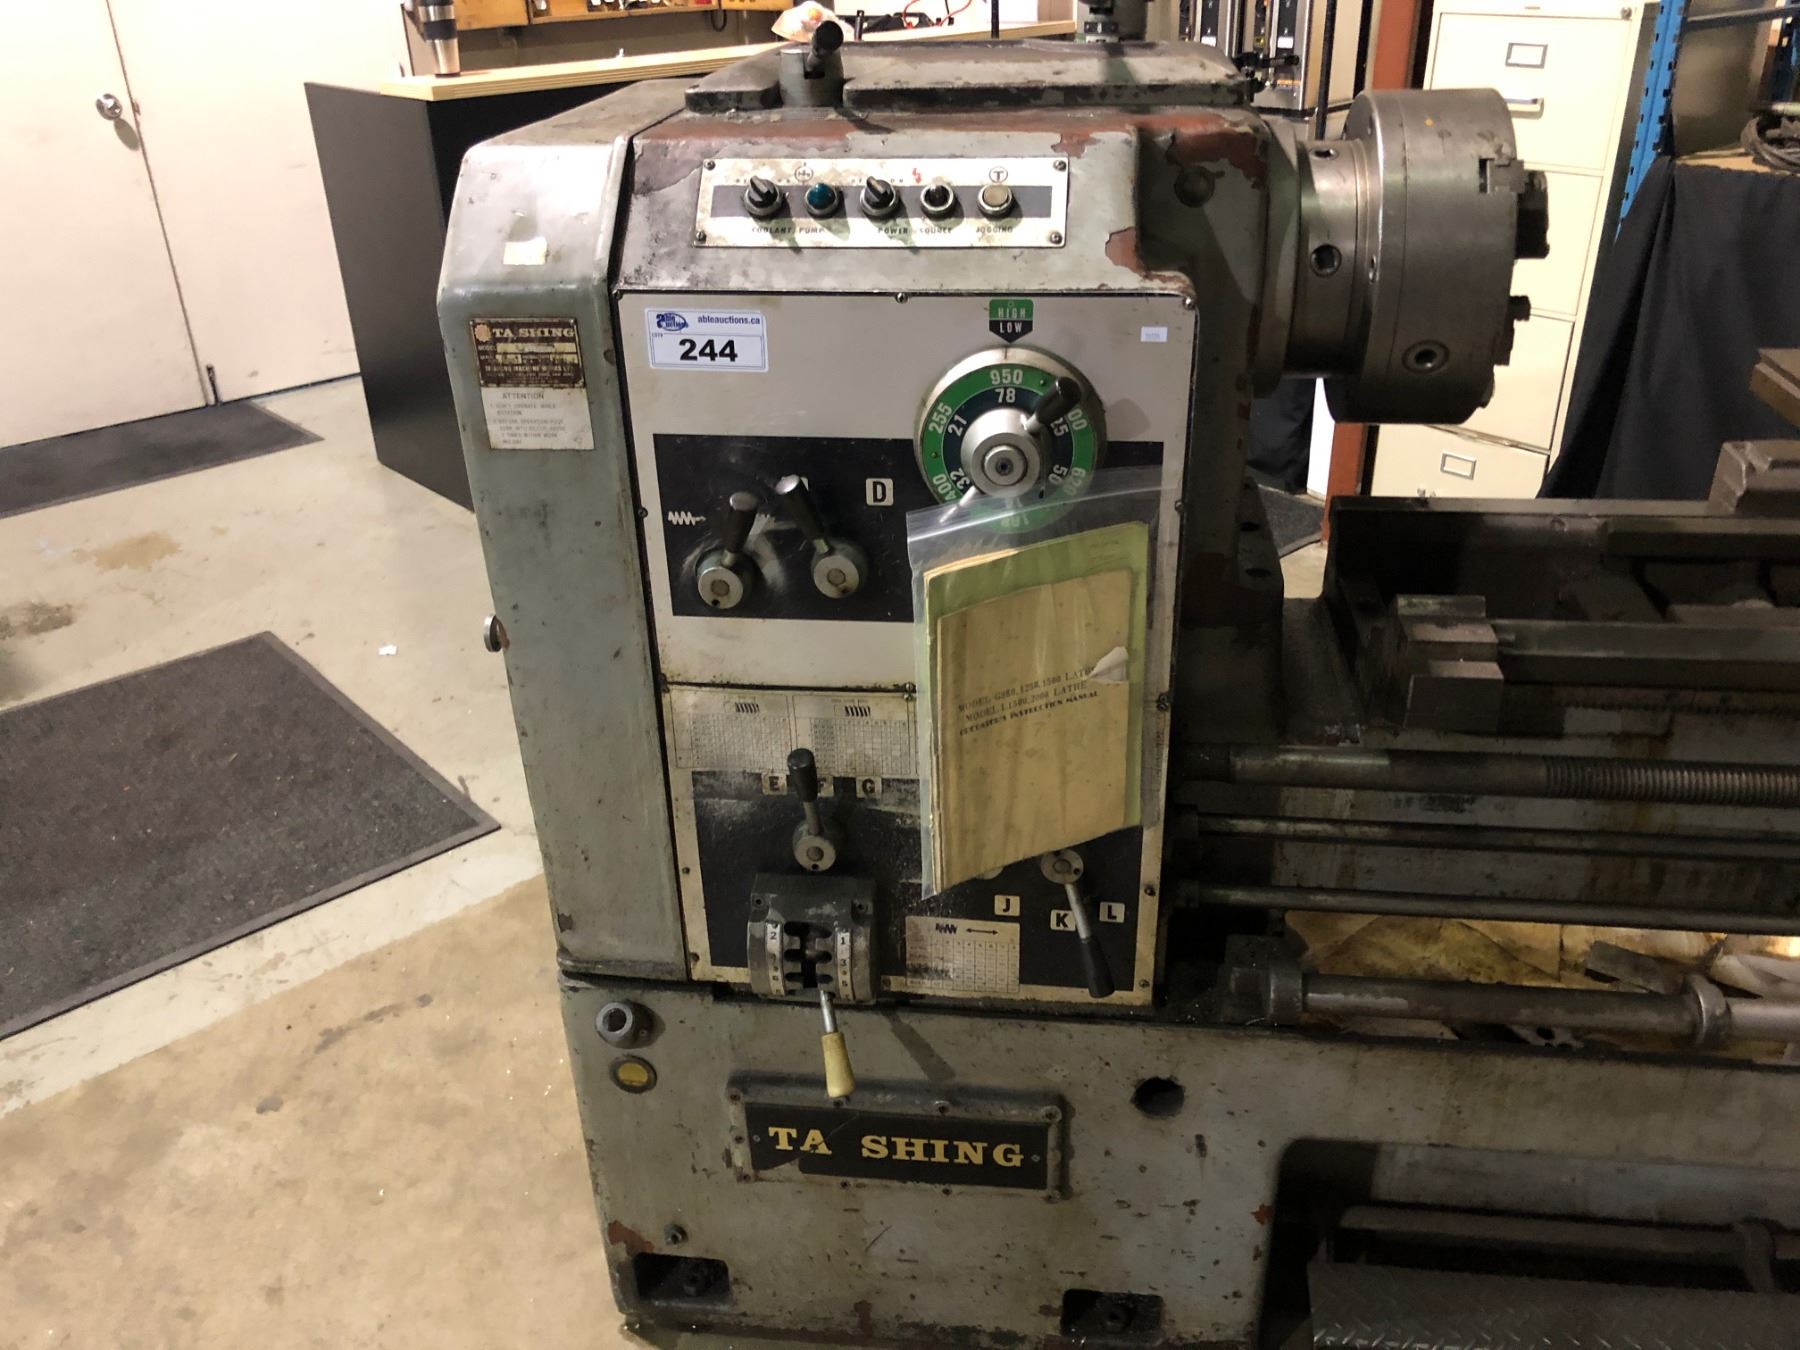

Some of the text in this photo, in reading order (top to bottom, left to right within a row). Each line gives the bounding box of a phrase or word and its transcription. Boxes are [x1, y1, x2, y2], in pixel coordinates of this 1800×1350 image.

[751, 226, 792, 234] COOLANT
[878, 226, 952, 234] POWER SOURCE
[976, 226, 1013, 234] JOGGING
[698, 315, 761, 325] ableauctions.ca
[998, 308, 1027, 318] HIGH
[492, 328, 575, 338] TA SHING
[1000, 322, 1022, 333] LOW
[679, 338, 738, 362] 244
[990, 369, 1023, 385] 950
[995, 388, 1016, 403] 78
[928, 402, 953, 434] 255
[947, 413, 968, 437] 21
[950, 467, 971, 490] 32
[1048, 464, 1068, 485] 50
[1063, 467, 1087, 496] 620
[872, 481, 887, 502] D
[932, 474, 957, 501] 400
[1053, 680, 1087, 697] LATHE
[769, 776, 779, 791] E
[862, 778, 875, 793] G
[1002, 898, 1011, 912] J
[1107, 905, 1117, 920] L
[1056, 913, 1068, 928] K
[770, 932, 777, 940] 2
[768, 1127, 1024, 1168] TA SHING
